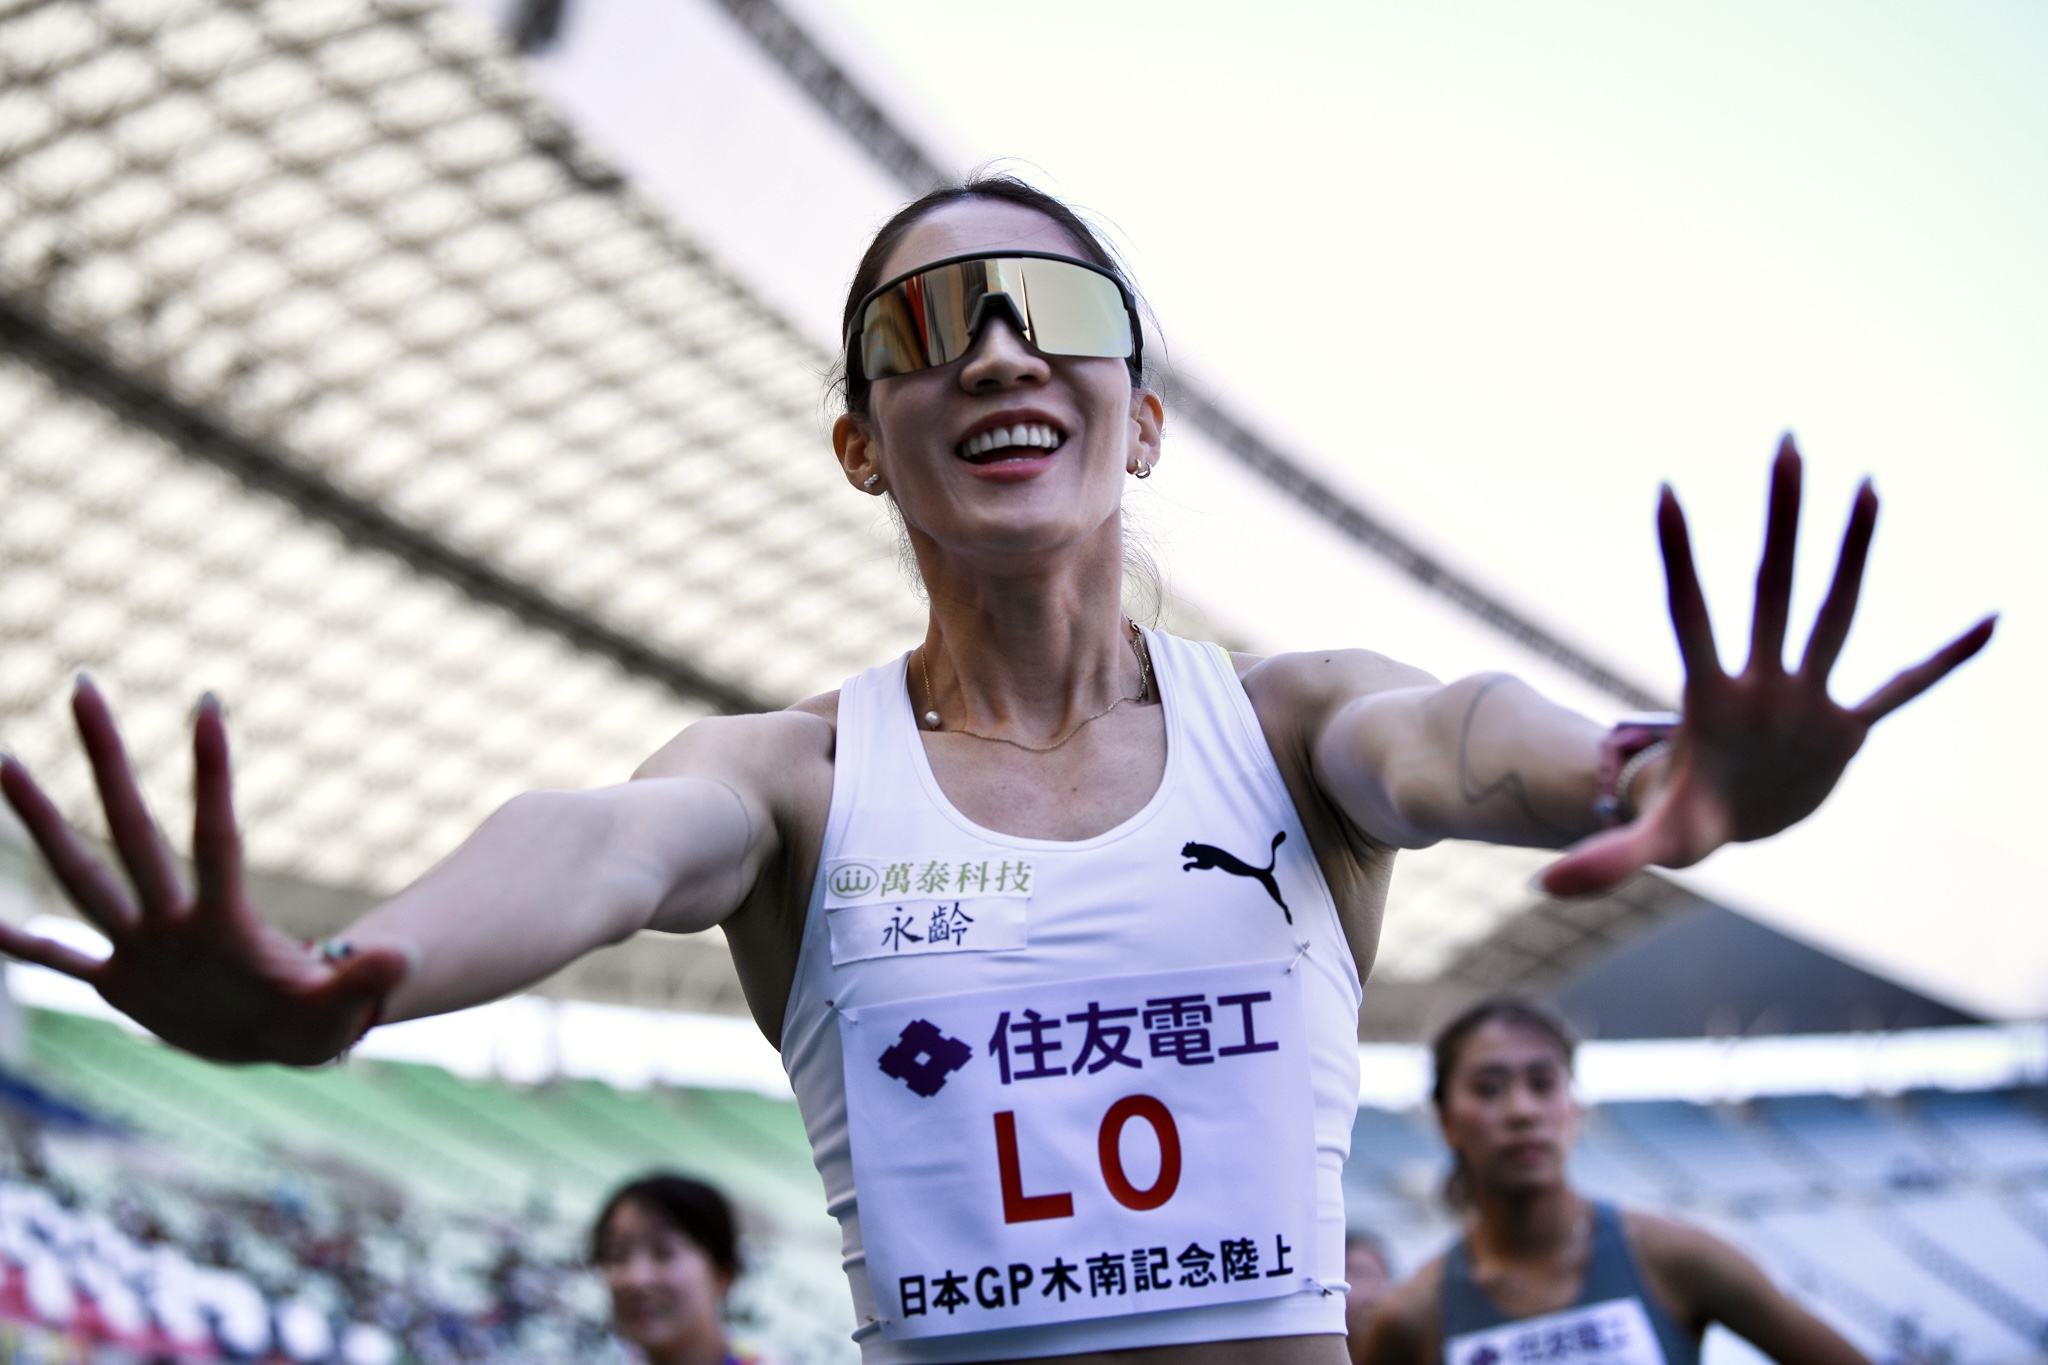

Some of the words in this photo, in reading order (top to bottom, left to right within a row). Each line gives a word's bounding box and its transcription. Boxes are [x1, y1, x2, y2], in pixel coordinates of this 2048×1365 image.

[880, 860, 1032, 897] 萬泰科技
[881, 902, 974, 951] 永齡
[989, 991, 1279, 1085] 住友電工
[993, 1094, 1182, 1224] LO
[899, 1234, 1294, 1318] 日本GP木南記念陸上
